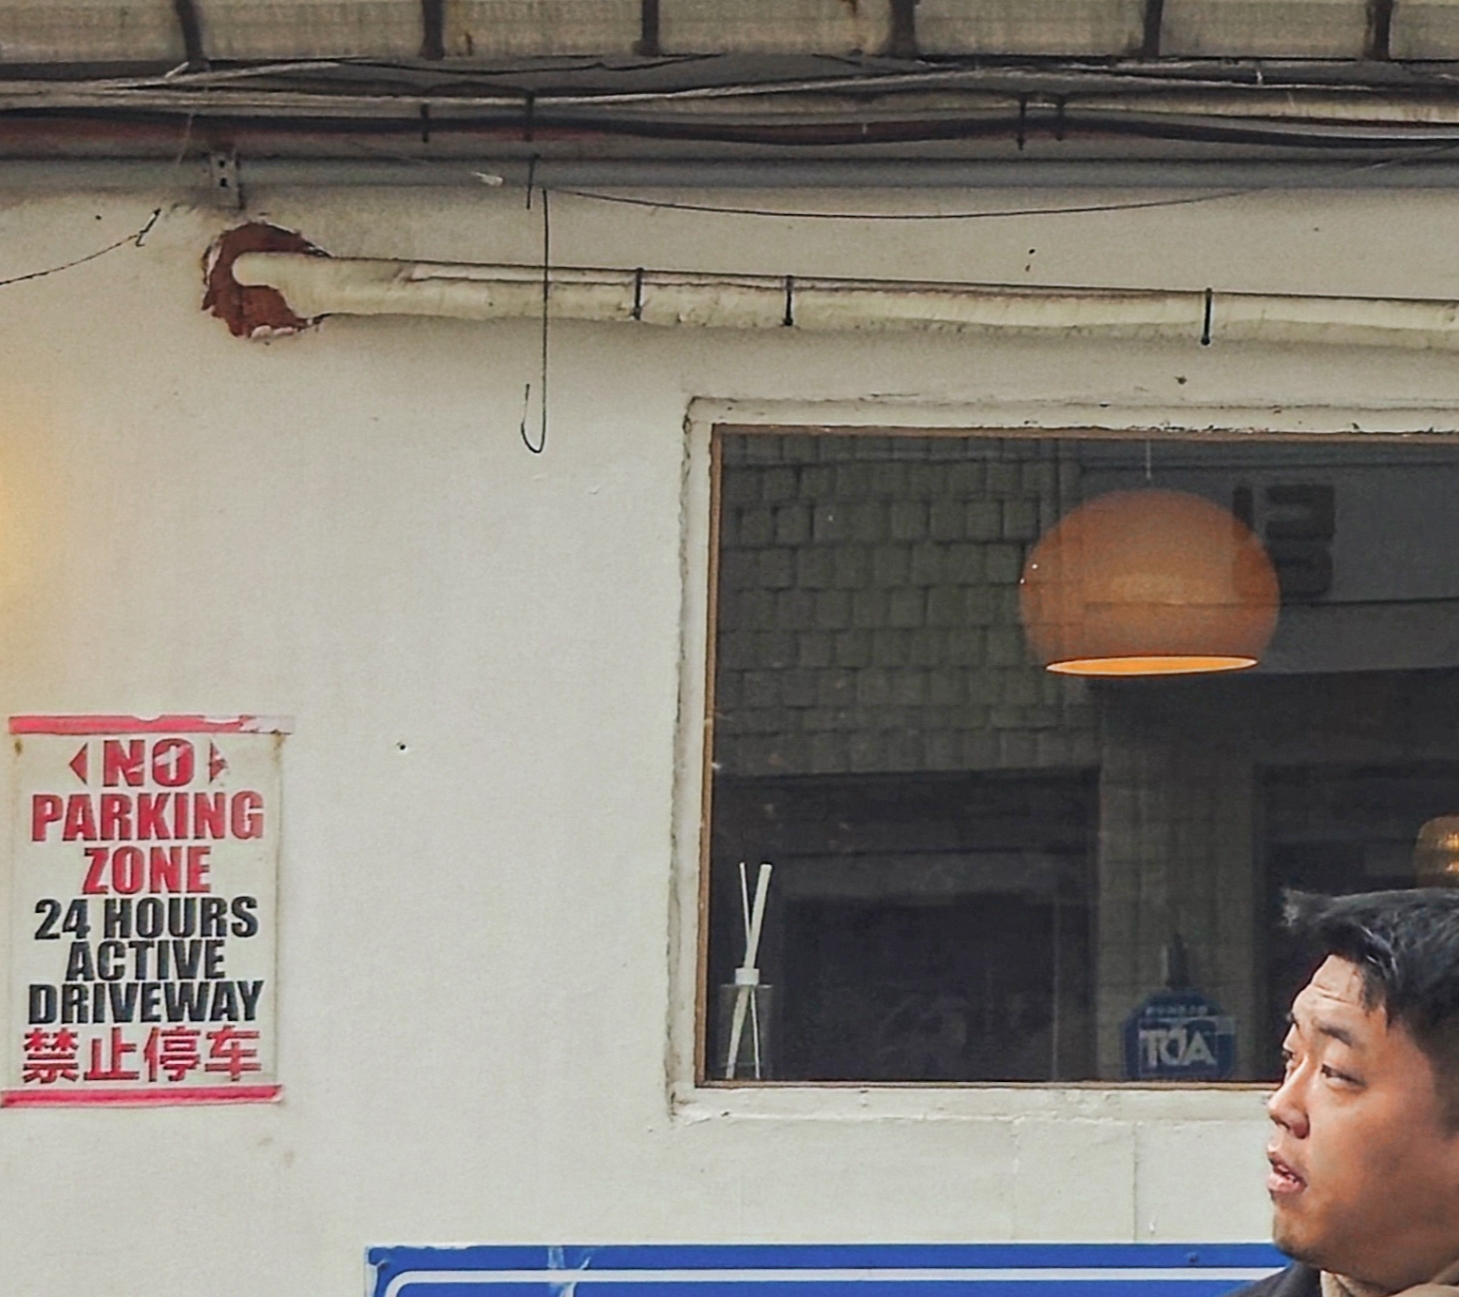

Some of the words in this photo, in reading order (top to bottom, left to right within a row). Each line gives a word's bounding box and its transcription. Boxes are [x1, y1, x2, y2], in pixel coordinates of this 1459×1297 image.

[102, 738, 195, 788] NO
[31, 791, 264, 842] PARKING
[82, 846, 211, 895] ZONE
[33, 898, 91, 941] 24
[103, 896, 259, 941] HOURS
[64, 938, 226, 982] ACTIVE
[27, 980, 265, 1026] DRIVEWAY
[21, 1025, 262, 1084] 禁止停车
